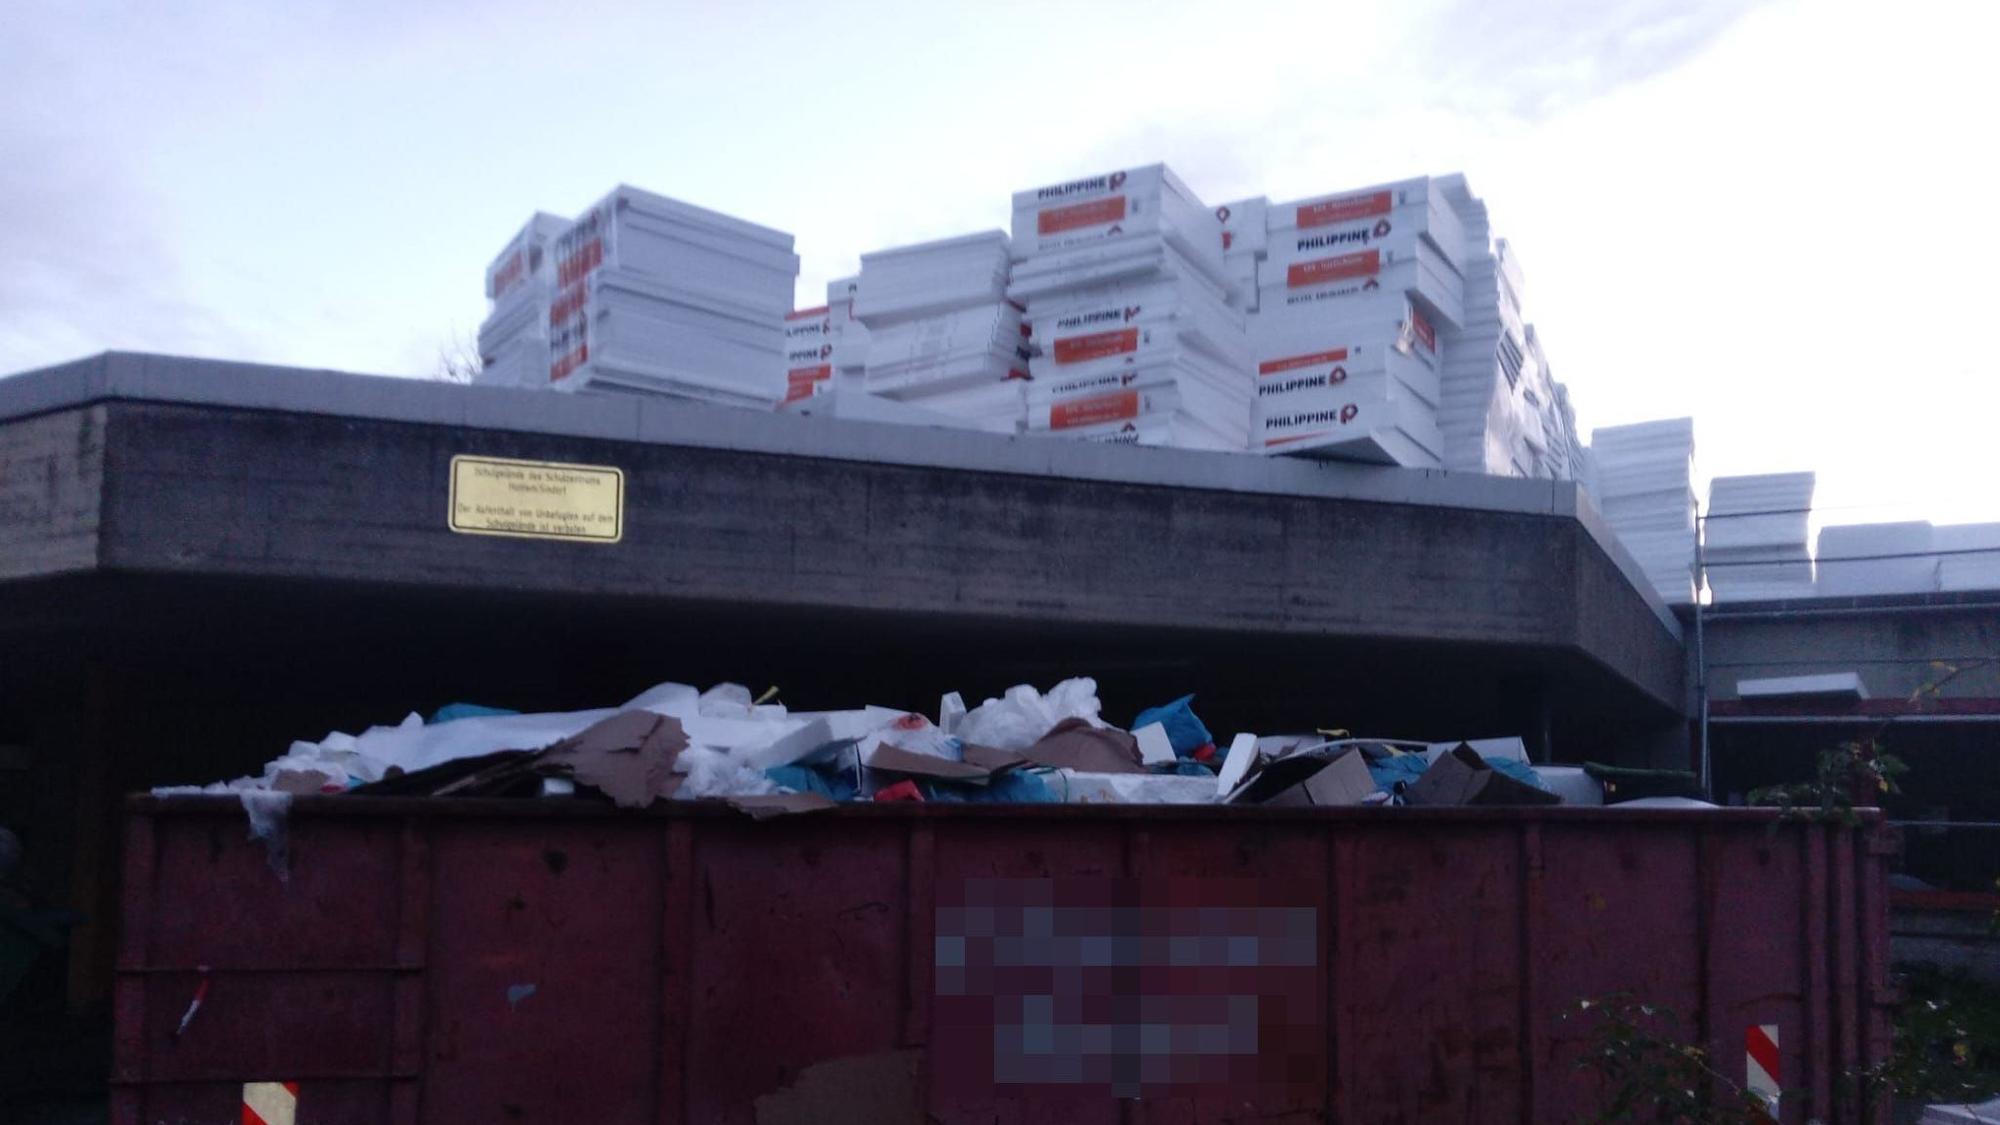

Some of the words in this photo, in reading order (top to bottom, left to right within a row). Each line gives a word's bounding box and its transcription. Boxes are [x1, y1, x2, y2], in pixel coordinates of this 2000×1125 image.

[1038, 177, 1107, 199] PHILIPPINE
[1297, 228, 1369, 251] PHILIPPINE
[1259, 374, 1326, 397] PHILIPPINE
[1266, 409, 1337, 429] PHILIPPINE
